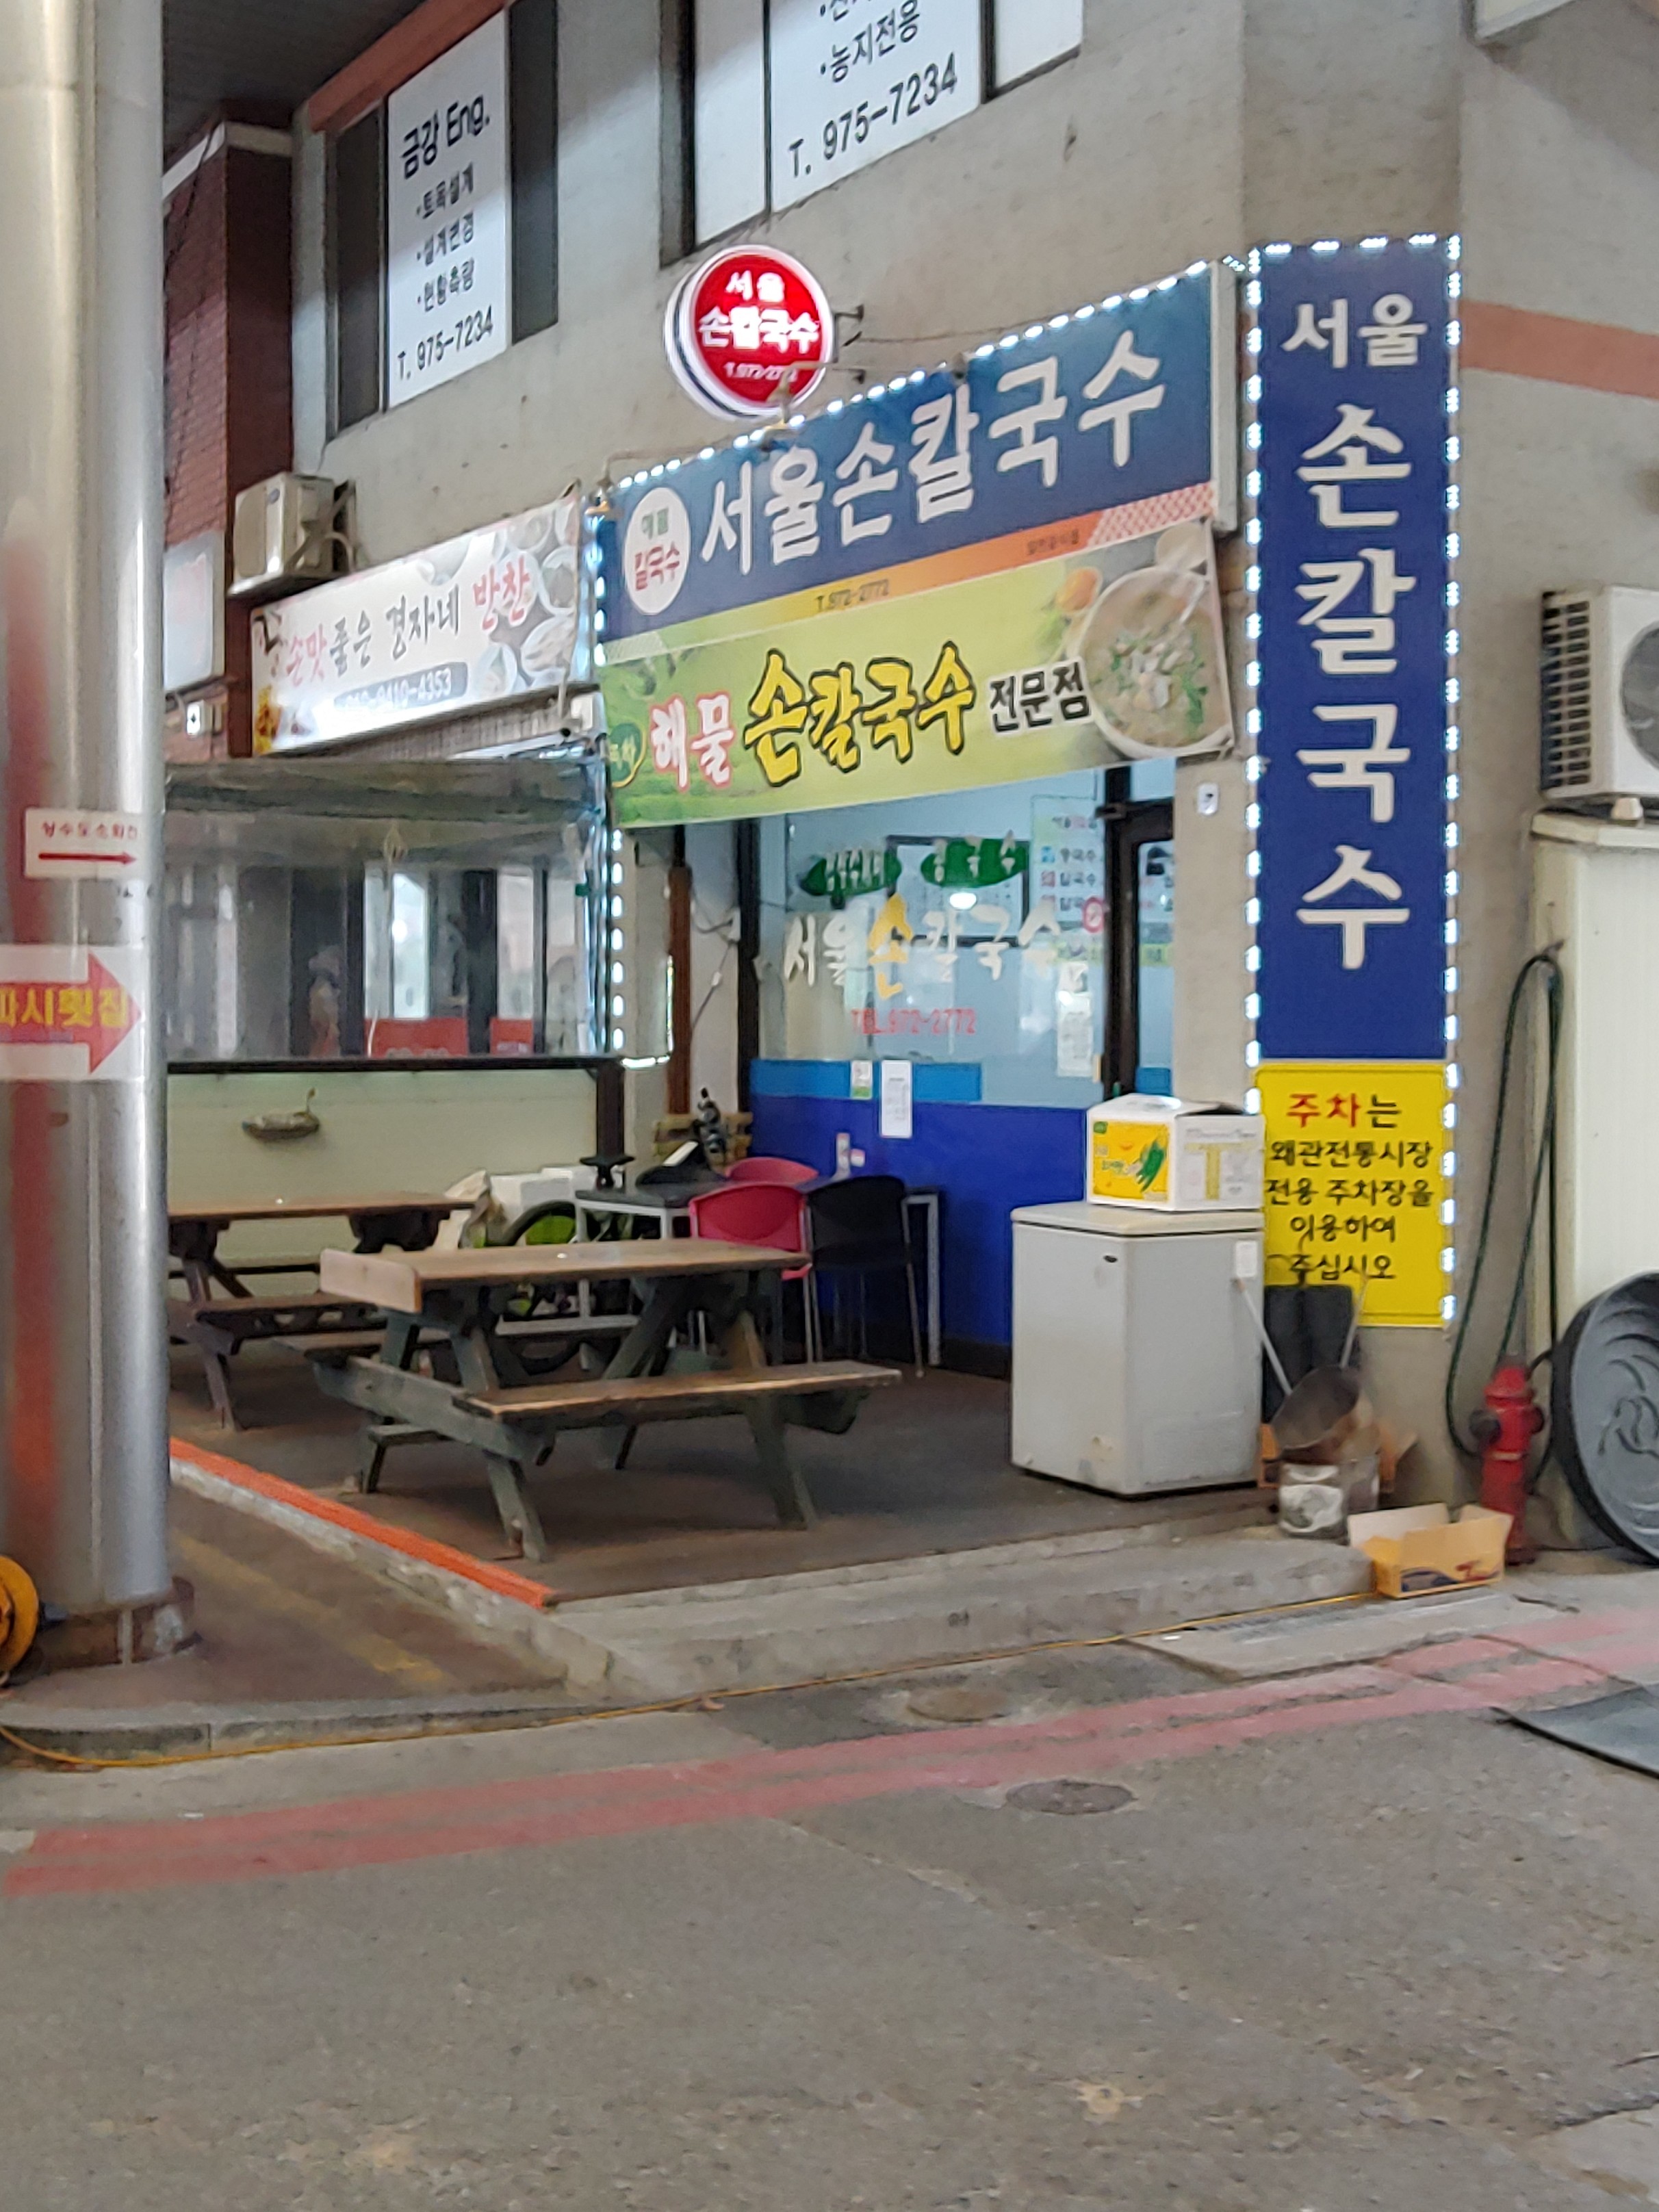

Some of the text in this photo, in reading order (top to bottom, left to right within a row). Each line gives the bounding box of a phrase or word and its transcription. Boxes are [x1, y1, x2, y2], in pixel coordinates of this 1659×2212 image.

[830, 0, 921, 83] 농지전용
[401, 94, 490, 179] 금강 Eng.
[823, 52, 957, 160] 975-7234
[725, 270, 785, 302] 서울
[417, 305, 493, 371] 975-7234
[698, 305, 820, 354] 손칼국수
[1280, 294, 1428, 369] 서울
[702, 329, 1166, 576] 서울손칼국수
[473, 554, 530, 630] 반찬
[650, 693, 735, 790] 해물
[744, 641, 977, 788] 손칼국수
[989, 662, 1092, 732] 전문점
[1295, 404, 1417, 970] 손칼국수
[1286, 1093, 1401, 1128] 주차는
[1270, 1140, 1432, 1168] 왜관전통시장
[1265, 1178, 1434, 1207] 전용 주차장을
[1290, 1214, 1396, 1243] 이용하여
[1289, 1255, 1396, 1285] 주십시오
